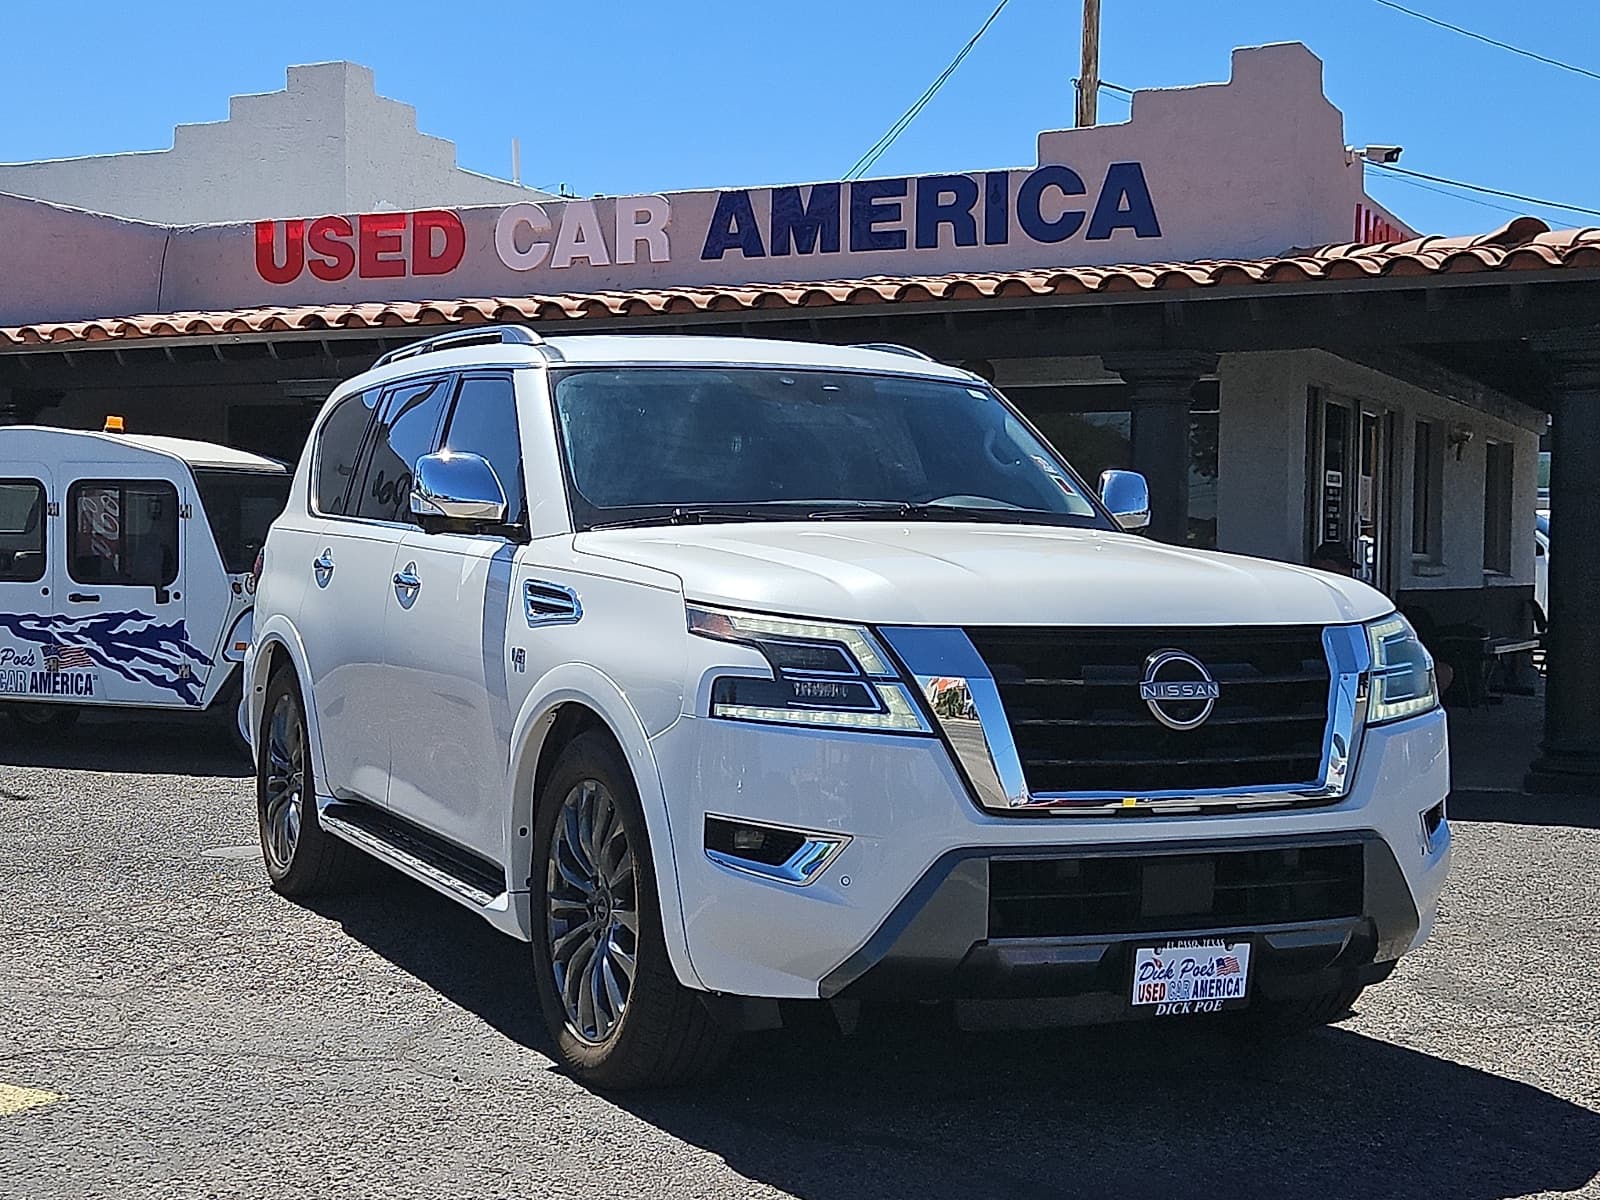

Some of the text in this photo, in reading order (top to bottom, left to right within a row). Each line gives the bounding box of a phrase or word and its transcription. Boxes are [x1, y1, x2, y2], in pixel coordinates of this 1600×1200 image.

[255, 161, 1162, 284] USED CAR AMERICA
[0, 647, 36, 667] Poe's
[29, 671, 94, 696] AMERICA
[1142, 685, 1218, 697] NISSAN
[1139, 956, 1215, 982] Dick Poe's
[1138, 977, 1241, 1003] USED CAR AMERICA
[1155, 999, 1224, 1016] DICK POE
